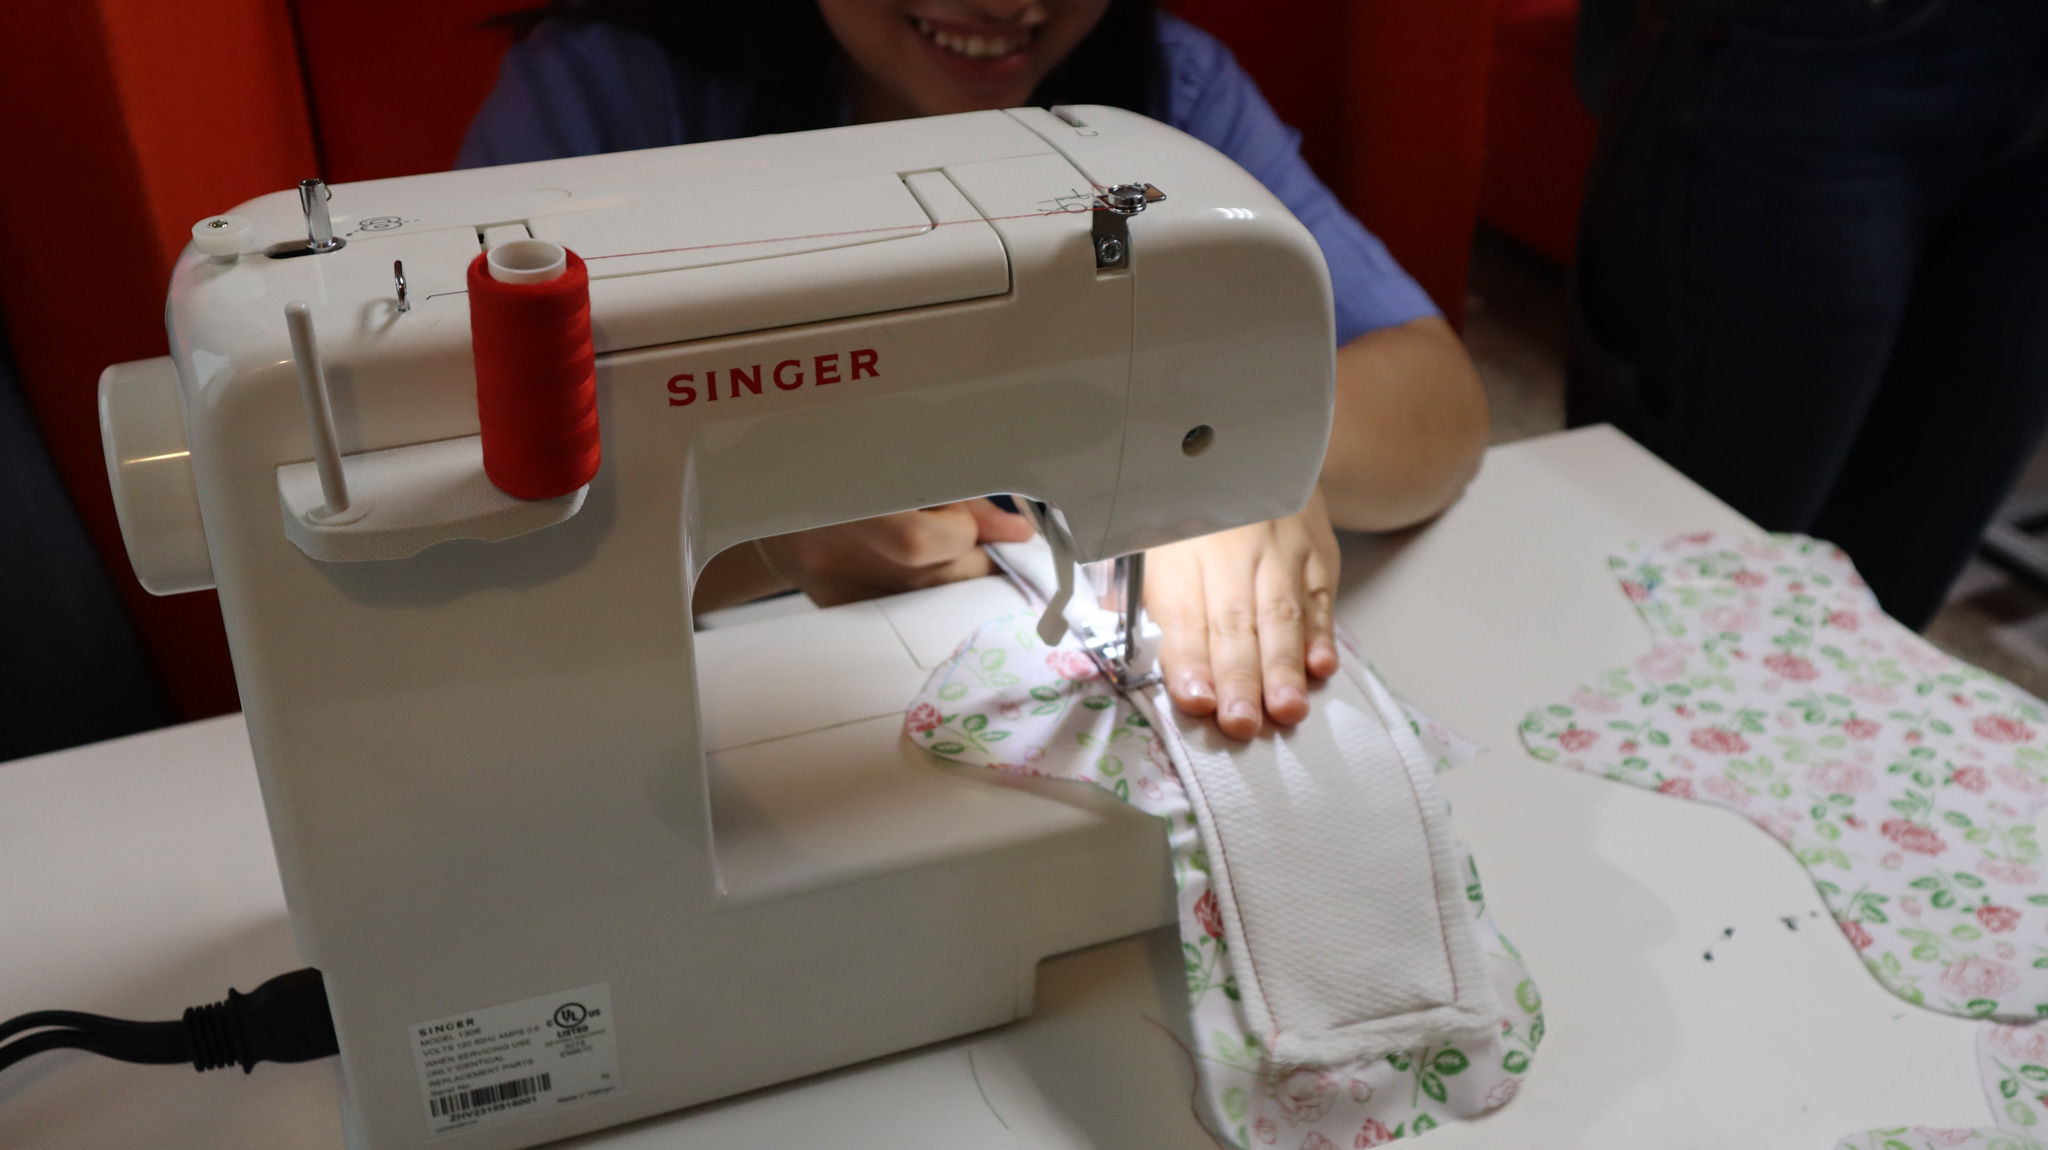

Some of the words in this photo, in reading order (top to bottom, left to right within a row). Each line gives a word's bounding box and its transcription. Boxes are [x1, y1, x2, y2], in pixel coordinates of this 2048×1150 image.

[667, 348, 881, 407] SINGER
[418, 1018, 475, 1037] SINGER
[420, 1034, 454, 1047] MODEL
[556, 1025, 589, 1038] LISTED
[422, 1044, 455, 1057] VOLTS
[498, 1028, 525, 1040] AMPS
[425, 1055, 455, 1068] WHEN
[457, 1043, 510, 1060] SERVICING
[511, 1038, 531, 1049] USE
[426, 1065, 453, 1078] ONLY
[454, 1055, 504, 1071] IDENTICAL
[428, 1064, 500, 1087] REPLACEMENT
[501, 1058, 535, 1071] PARTS
